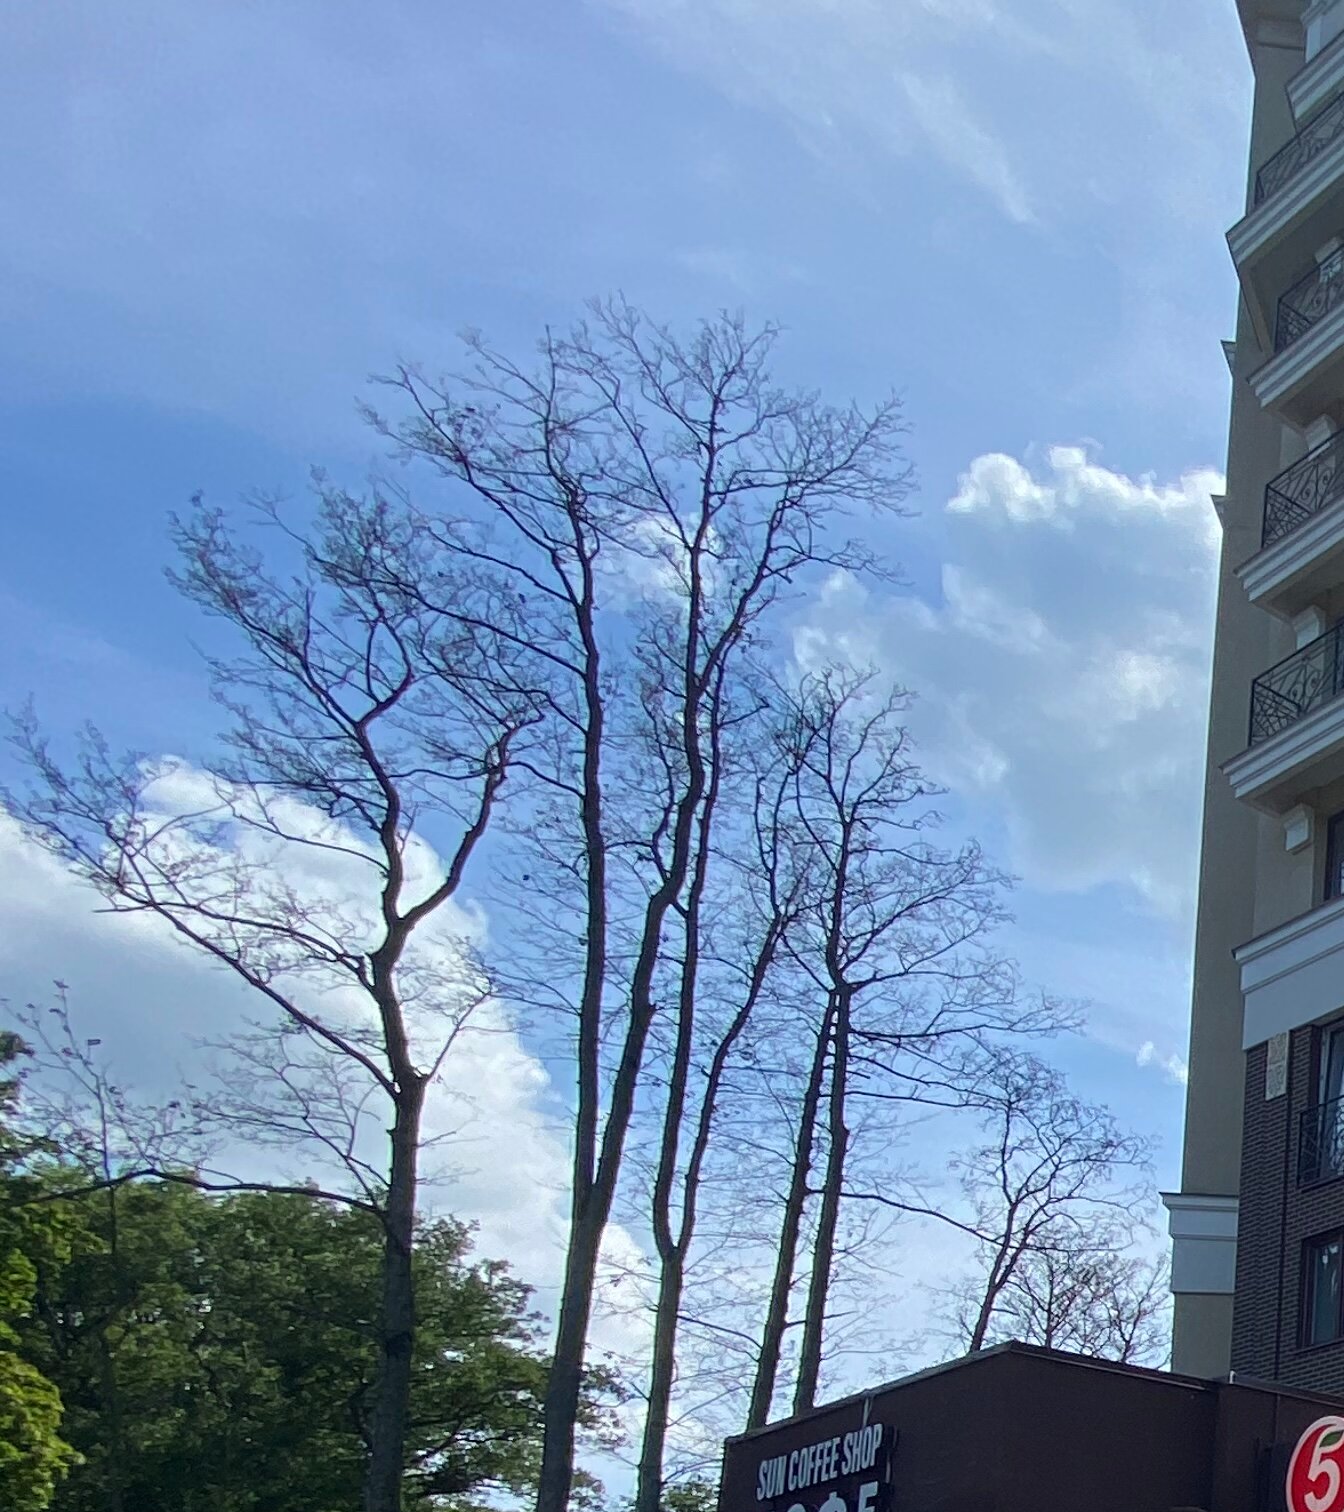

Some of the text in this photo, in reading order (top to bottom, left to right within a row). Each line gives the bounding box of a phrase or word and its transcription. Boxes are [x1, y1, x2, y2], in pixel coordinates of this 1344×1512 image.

[757, 1423, 883, 1500] SUN COFFEE SHOP
